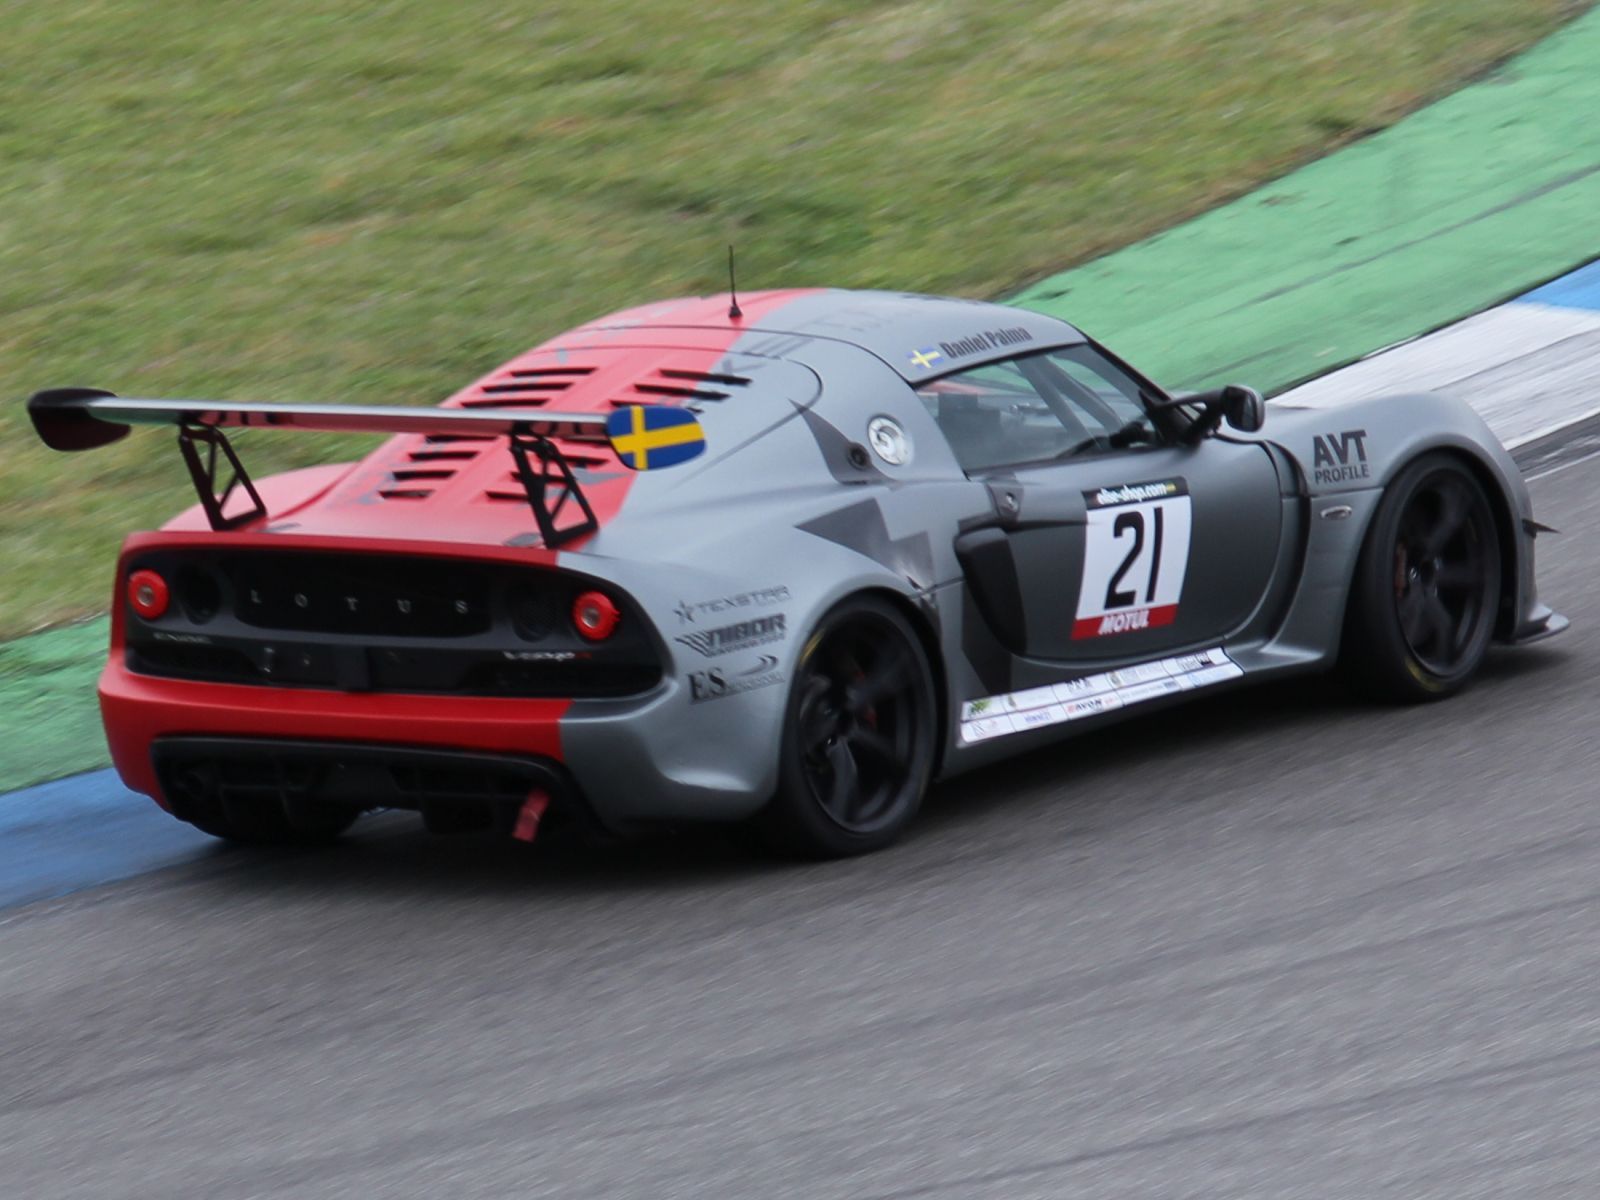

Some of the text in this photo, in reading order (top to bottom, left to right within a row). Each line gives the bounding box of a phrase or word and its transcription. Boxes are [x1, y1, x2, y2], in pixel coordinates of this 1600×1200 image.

[939, 326, 1033, 359] Daniel Palma
[1313, 429, 1367, 468] AVT
[1314, 463, 1370, 484] PROFILE
[1104, 506, 1163, 611] 21
[250, 589, 469, 614] LOTUS
[1098, 609, 1150, 635] MOTUL
